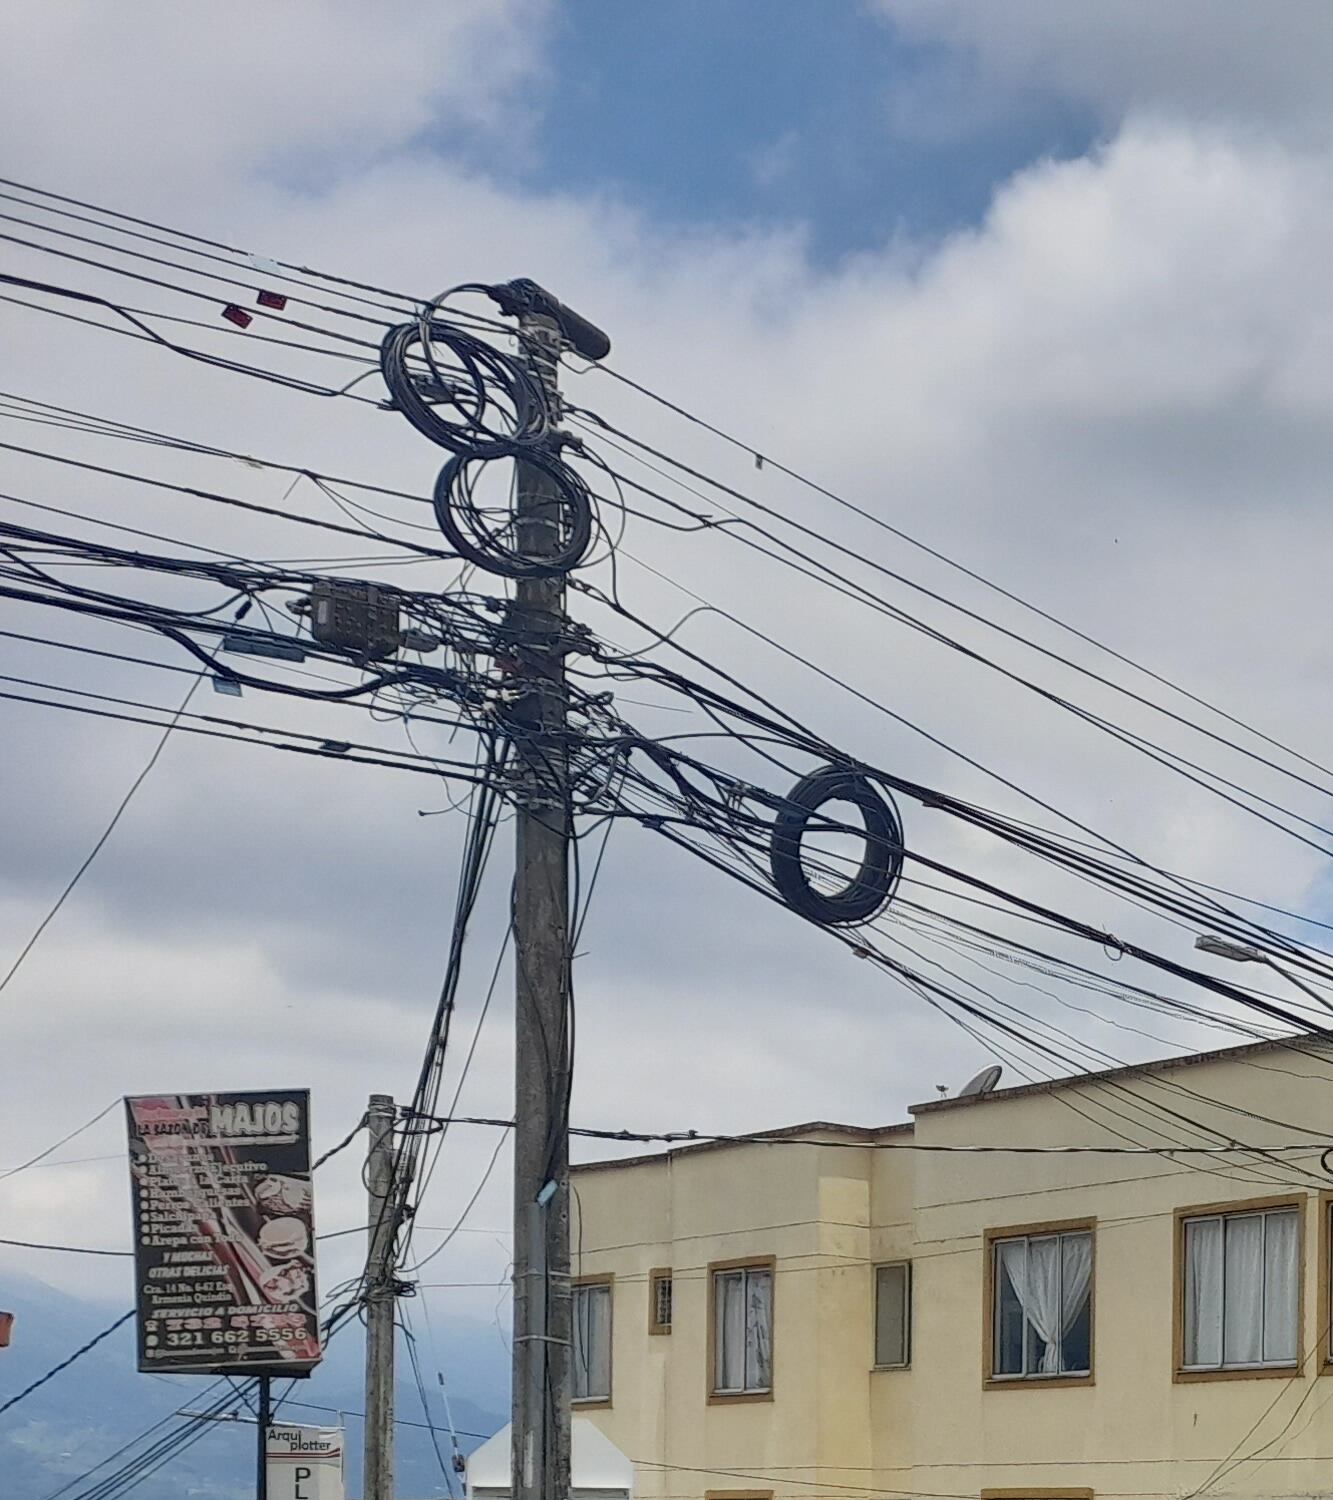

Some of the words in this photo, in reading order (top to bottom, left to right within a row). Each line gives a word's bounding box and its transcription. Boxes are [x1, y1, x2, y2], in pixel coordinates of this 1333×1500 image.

[210, 1101, 300, 1136] MAJOS
[151, 1236, 188, 1247] Arepa
[149, 1266, 182, 1278] OTRAS
[183, 1265, 230, 1277] DELICIAS
[152, 1294, 192, 1304] Armenia
[152, 1307, 212, 1319] SERVICIO
[215, 1307, 225, 1316] A
[228, 1303, 299, 1315] DOMICILIO
[167, 1332, 204, 1346] 321
[211, 1330, 249, 1344] 662
[255, 1328, 307, 1342] 5556
[290, 1438, 331, 1451] plotter
